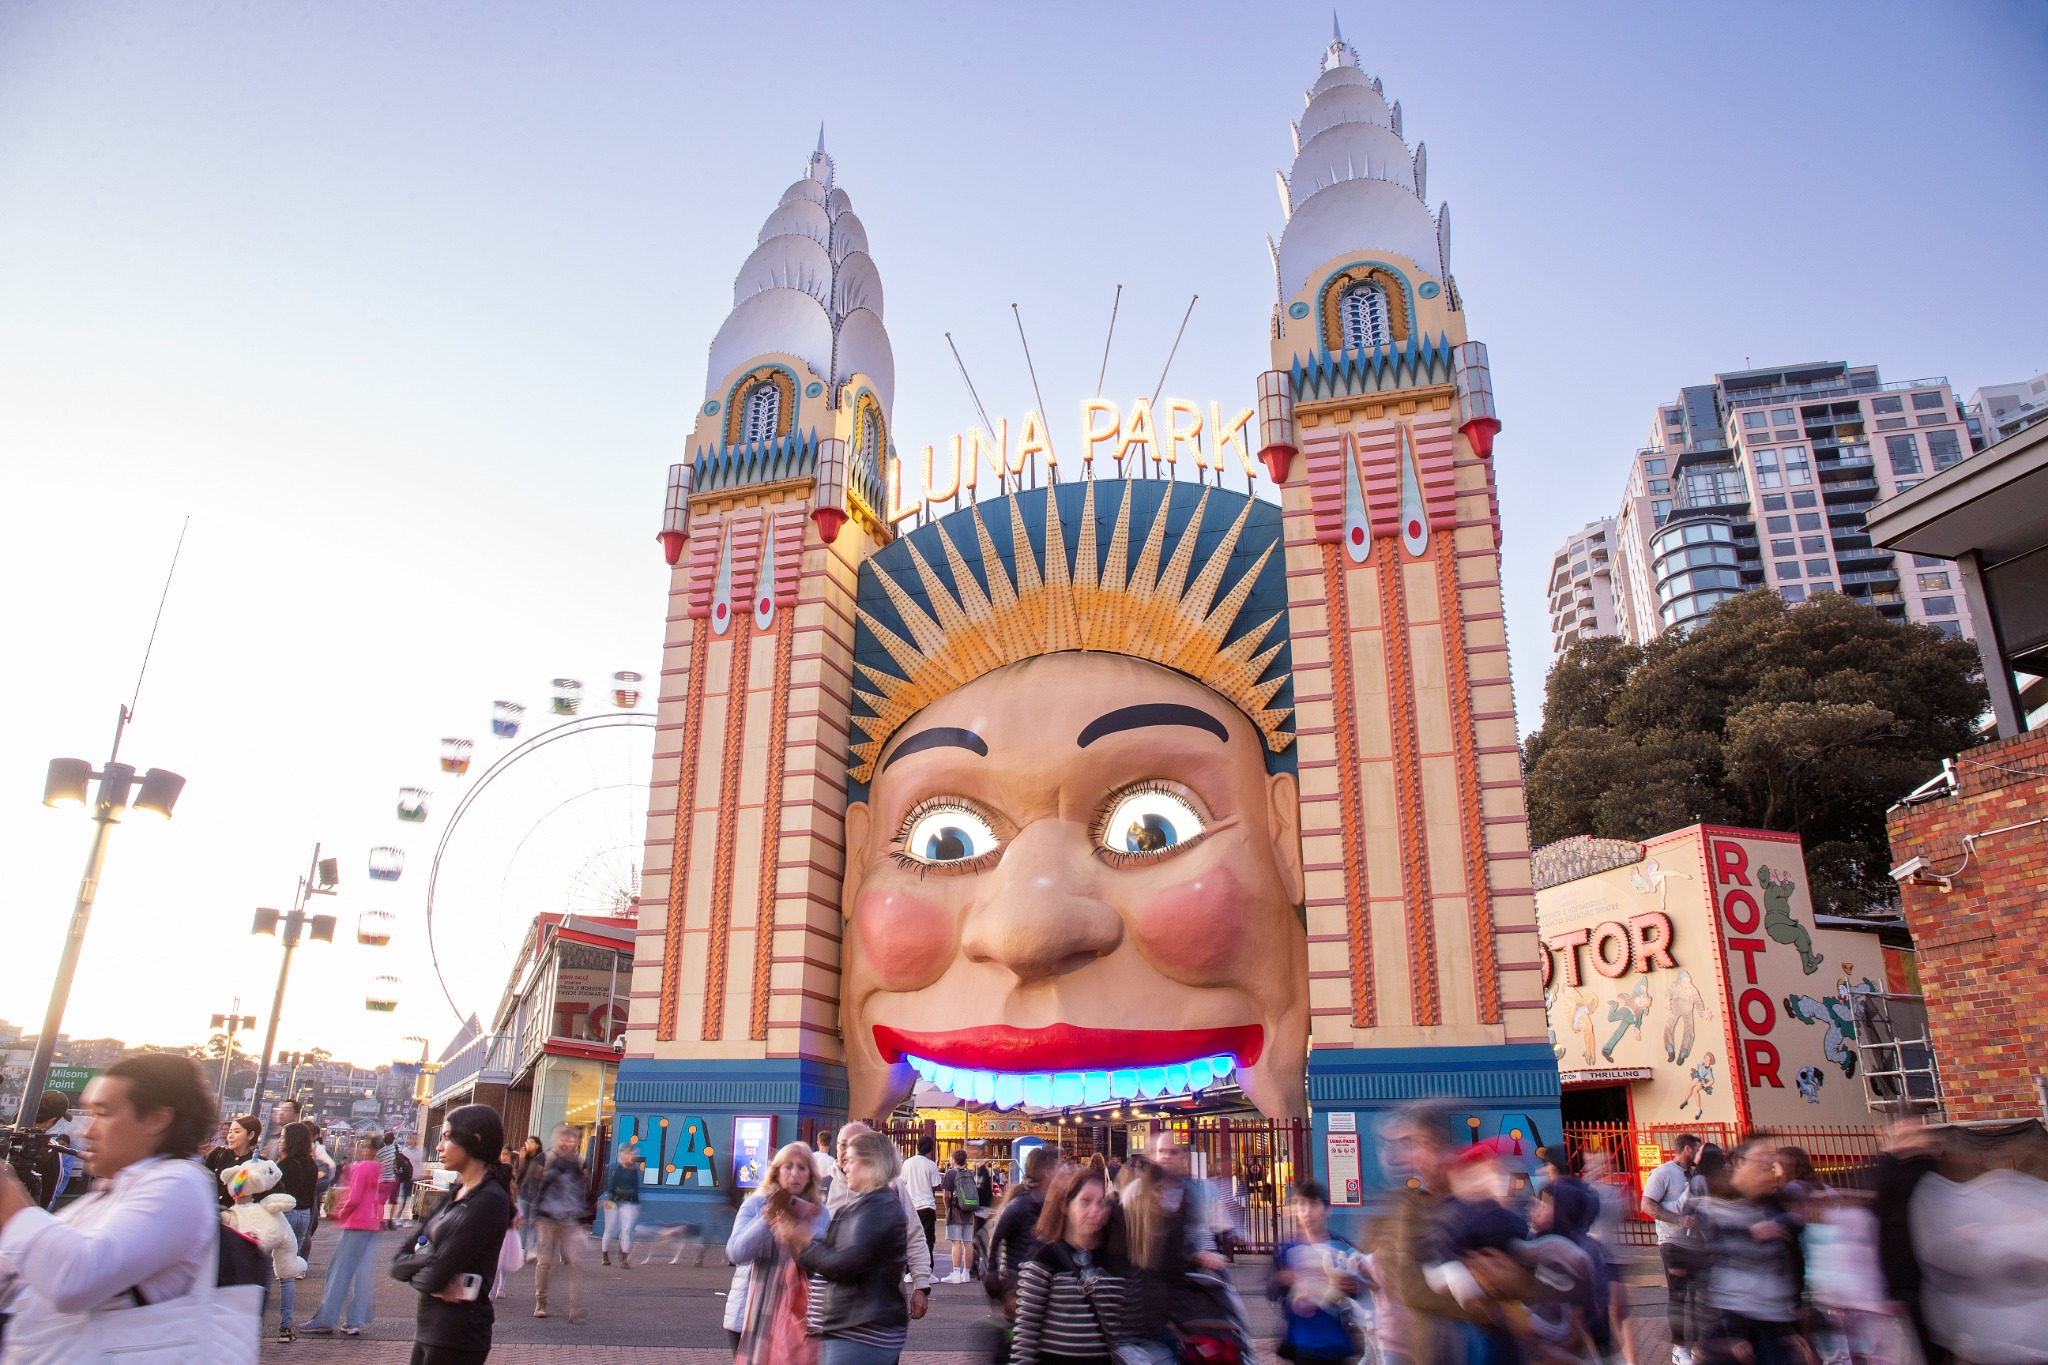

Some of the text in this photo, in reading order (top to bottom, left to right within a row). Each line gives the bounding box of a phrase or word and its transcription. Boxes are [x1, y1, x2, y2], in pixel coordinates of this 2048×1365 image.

[887, 397, 1257, 524] LUNA PARK
[1540, 911, 1680, 988] TOR
[1713, 840, 1785, 1088] ROTOR
[49, 1079, 75, 1089] Point
[51, 1069, 89, 1079] Milsons
[1589, 1071, 1640, 1079] THRILLING
